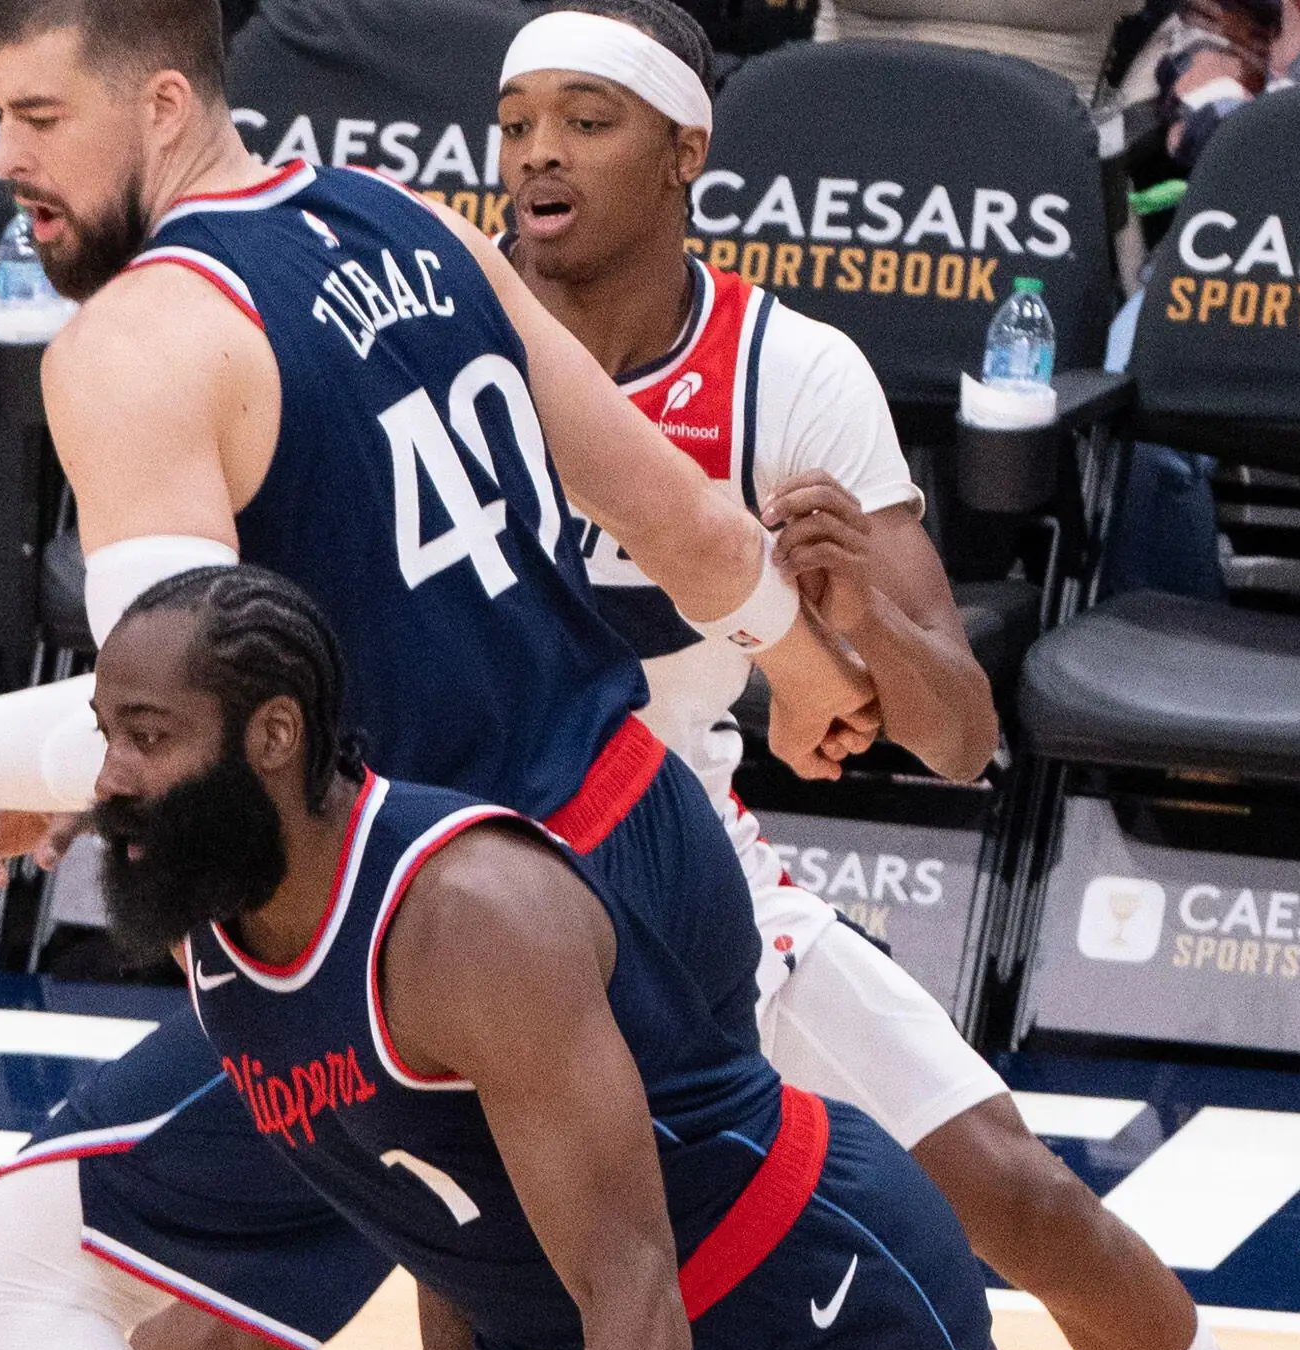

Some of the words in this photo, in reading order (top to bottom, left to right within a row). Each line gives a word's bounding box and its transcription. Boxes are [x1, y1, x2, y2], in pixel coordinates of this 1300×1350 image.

[690, 169, 1072, 258] CAESARS
[312, 248, 455, 360] ZUBAC
[655, 419, 720, 440] binhood
[376, 353, 561, 600] 40
[379, 1149, 481, 1226] 1
